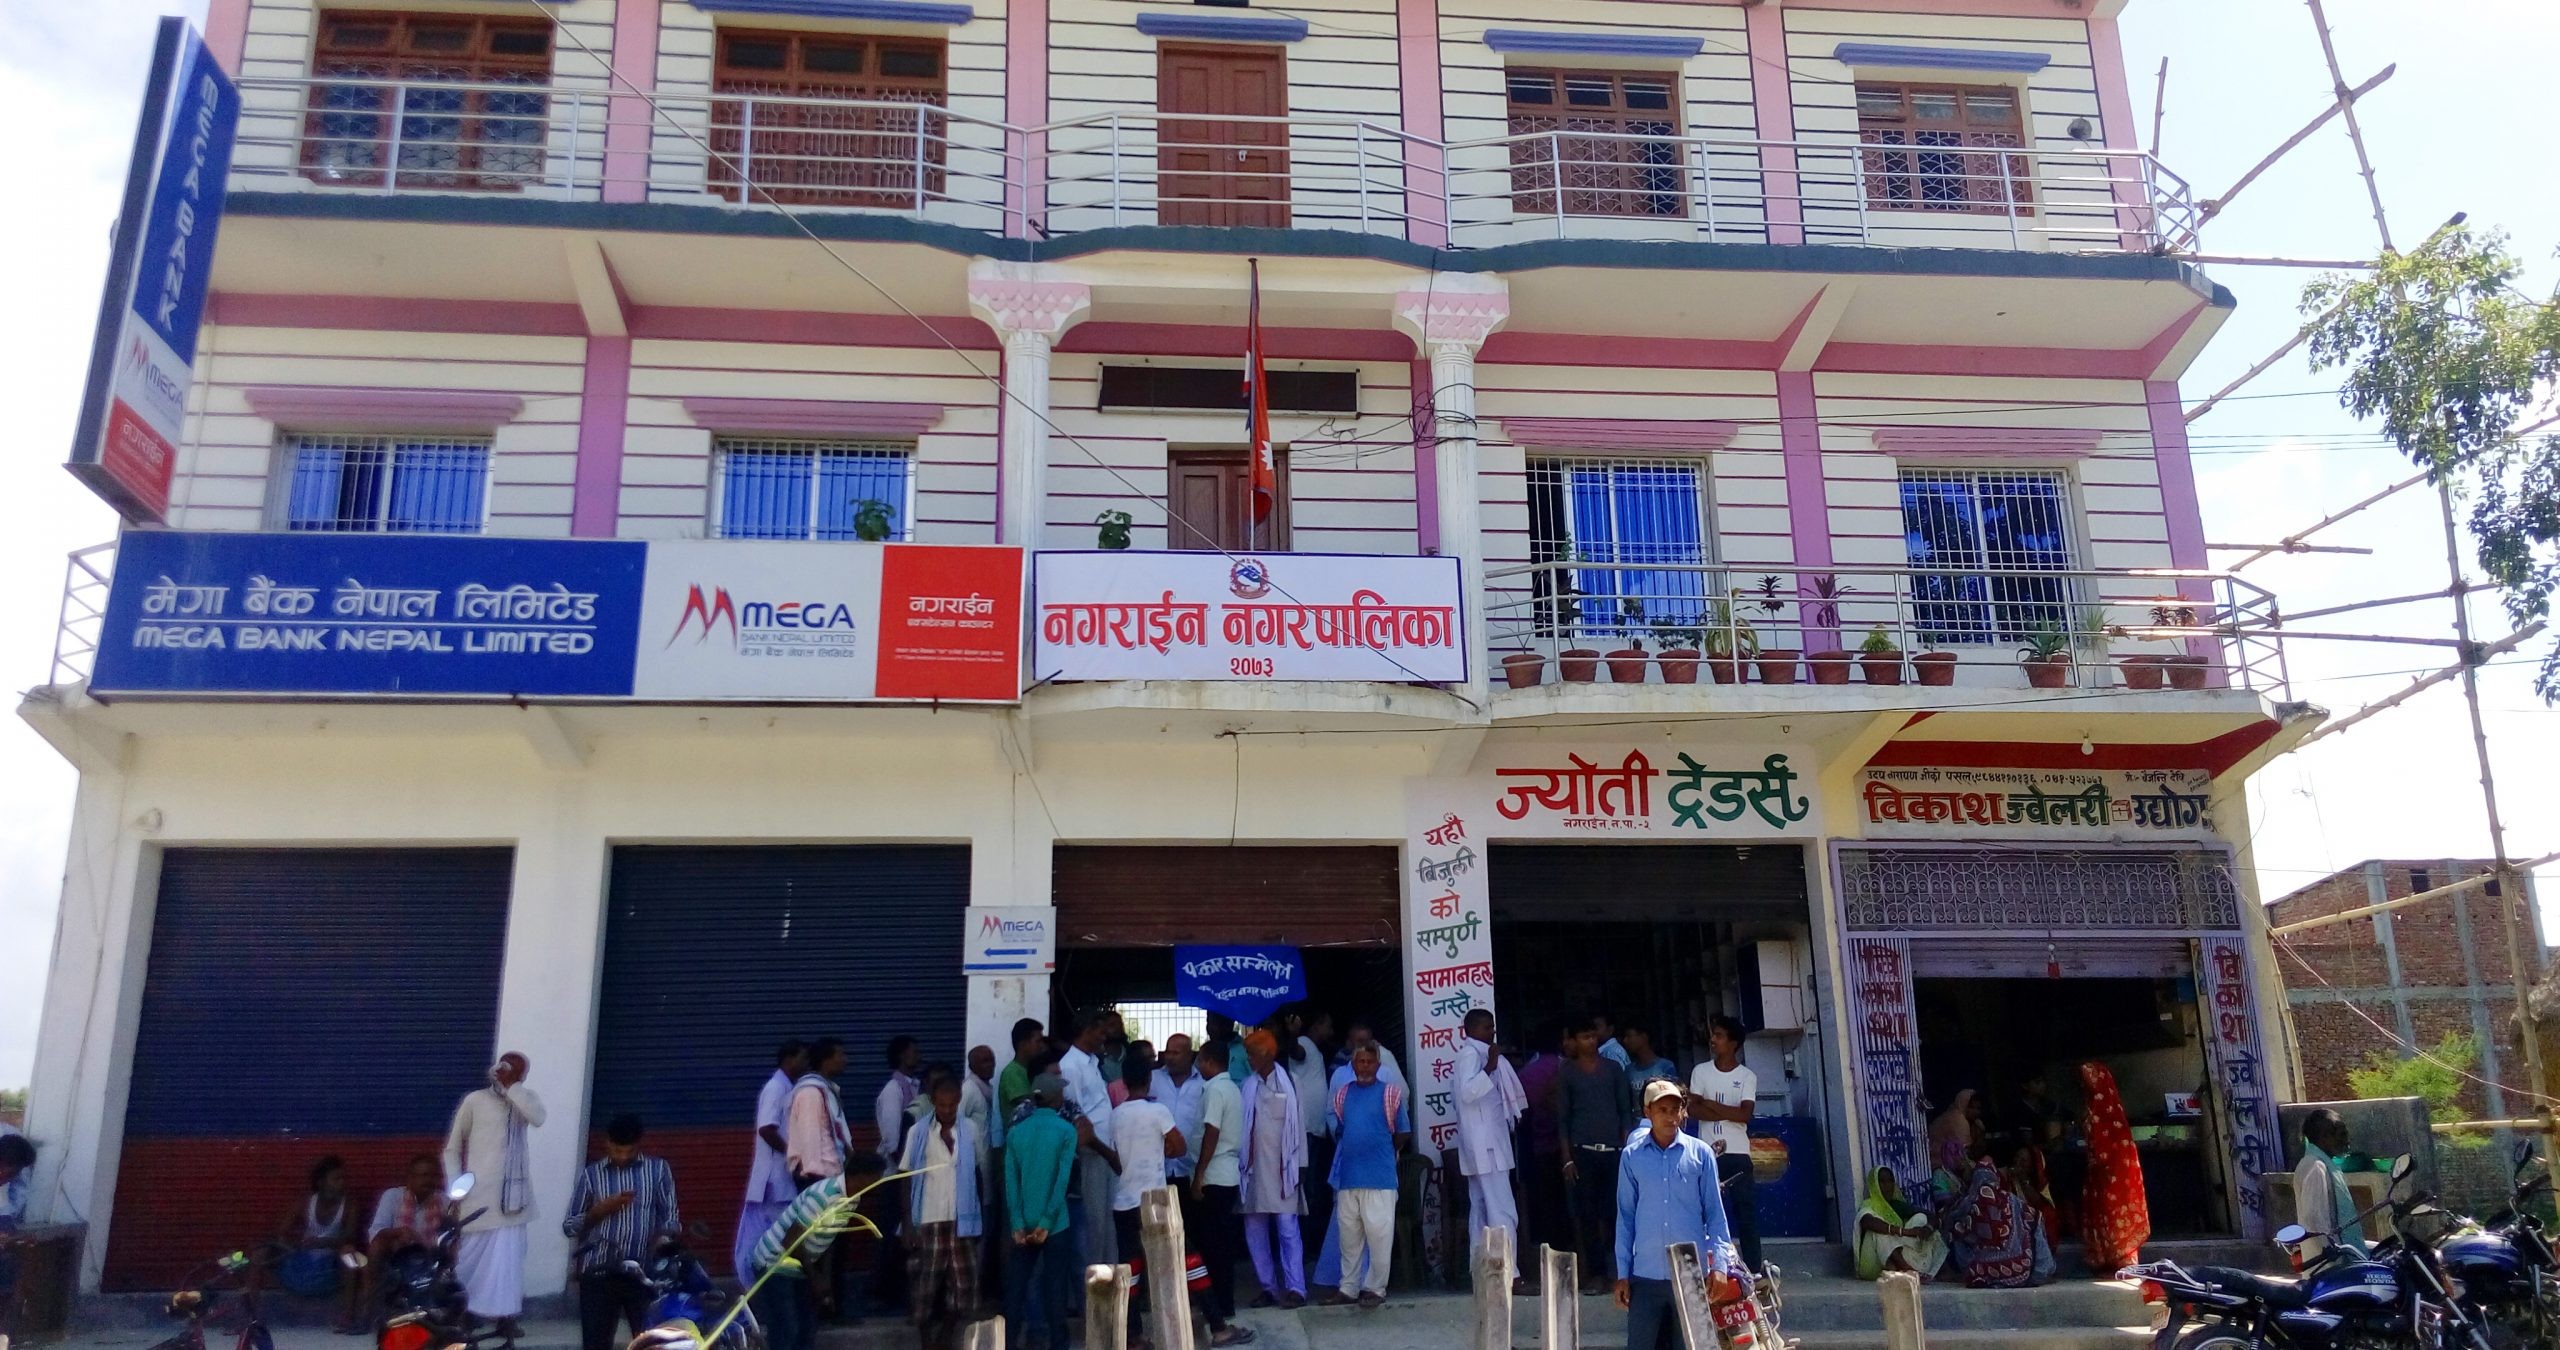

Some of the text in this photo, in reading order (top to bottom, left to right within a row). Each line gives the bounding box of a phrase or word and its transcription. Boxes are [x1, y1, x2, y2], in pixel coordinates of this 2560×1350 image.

[158, 74, 219, 333] MEGA BANK
[149, 363, 184, 411] MEGA
[142, 575, 599, 622] मेगा बैंक नेपाल लिमिटेड
[908, 592, 996, 617] नगराईन
[741, 602, 856, 629] MEGA
[1041, 588, 1456, 656] नगराईन नगरपालिका
[134, 626, 596, 656] MEGA BANK NEPAL LIMITED
[1229, 656, 1275, 679] २०७३
[1863, 780, 2006, 825] विकाश
[1430, 889, 1461, 920] को
[1003, 920, 1045, 932] MEGA
[1418, 1024, 1458, 1053] मोटर
